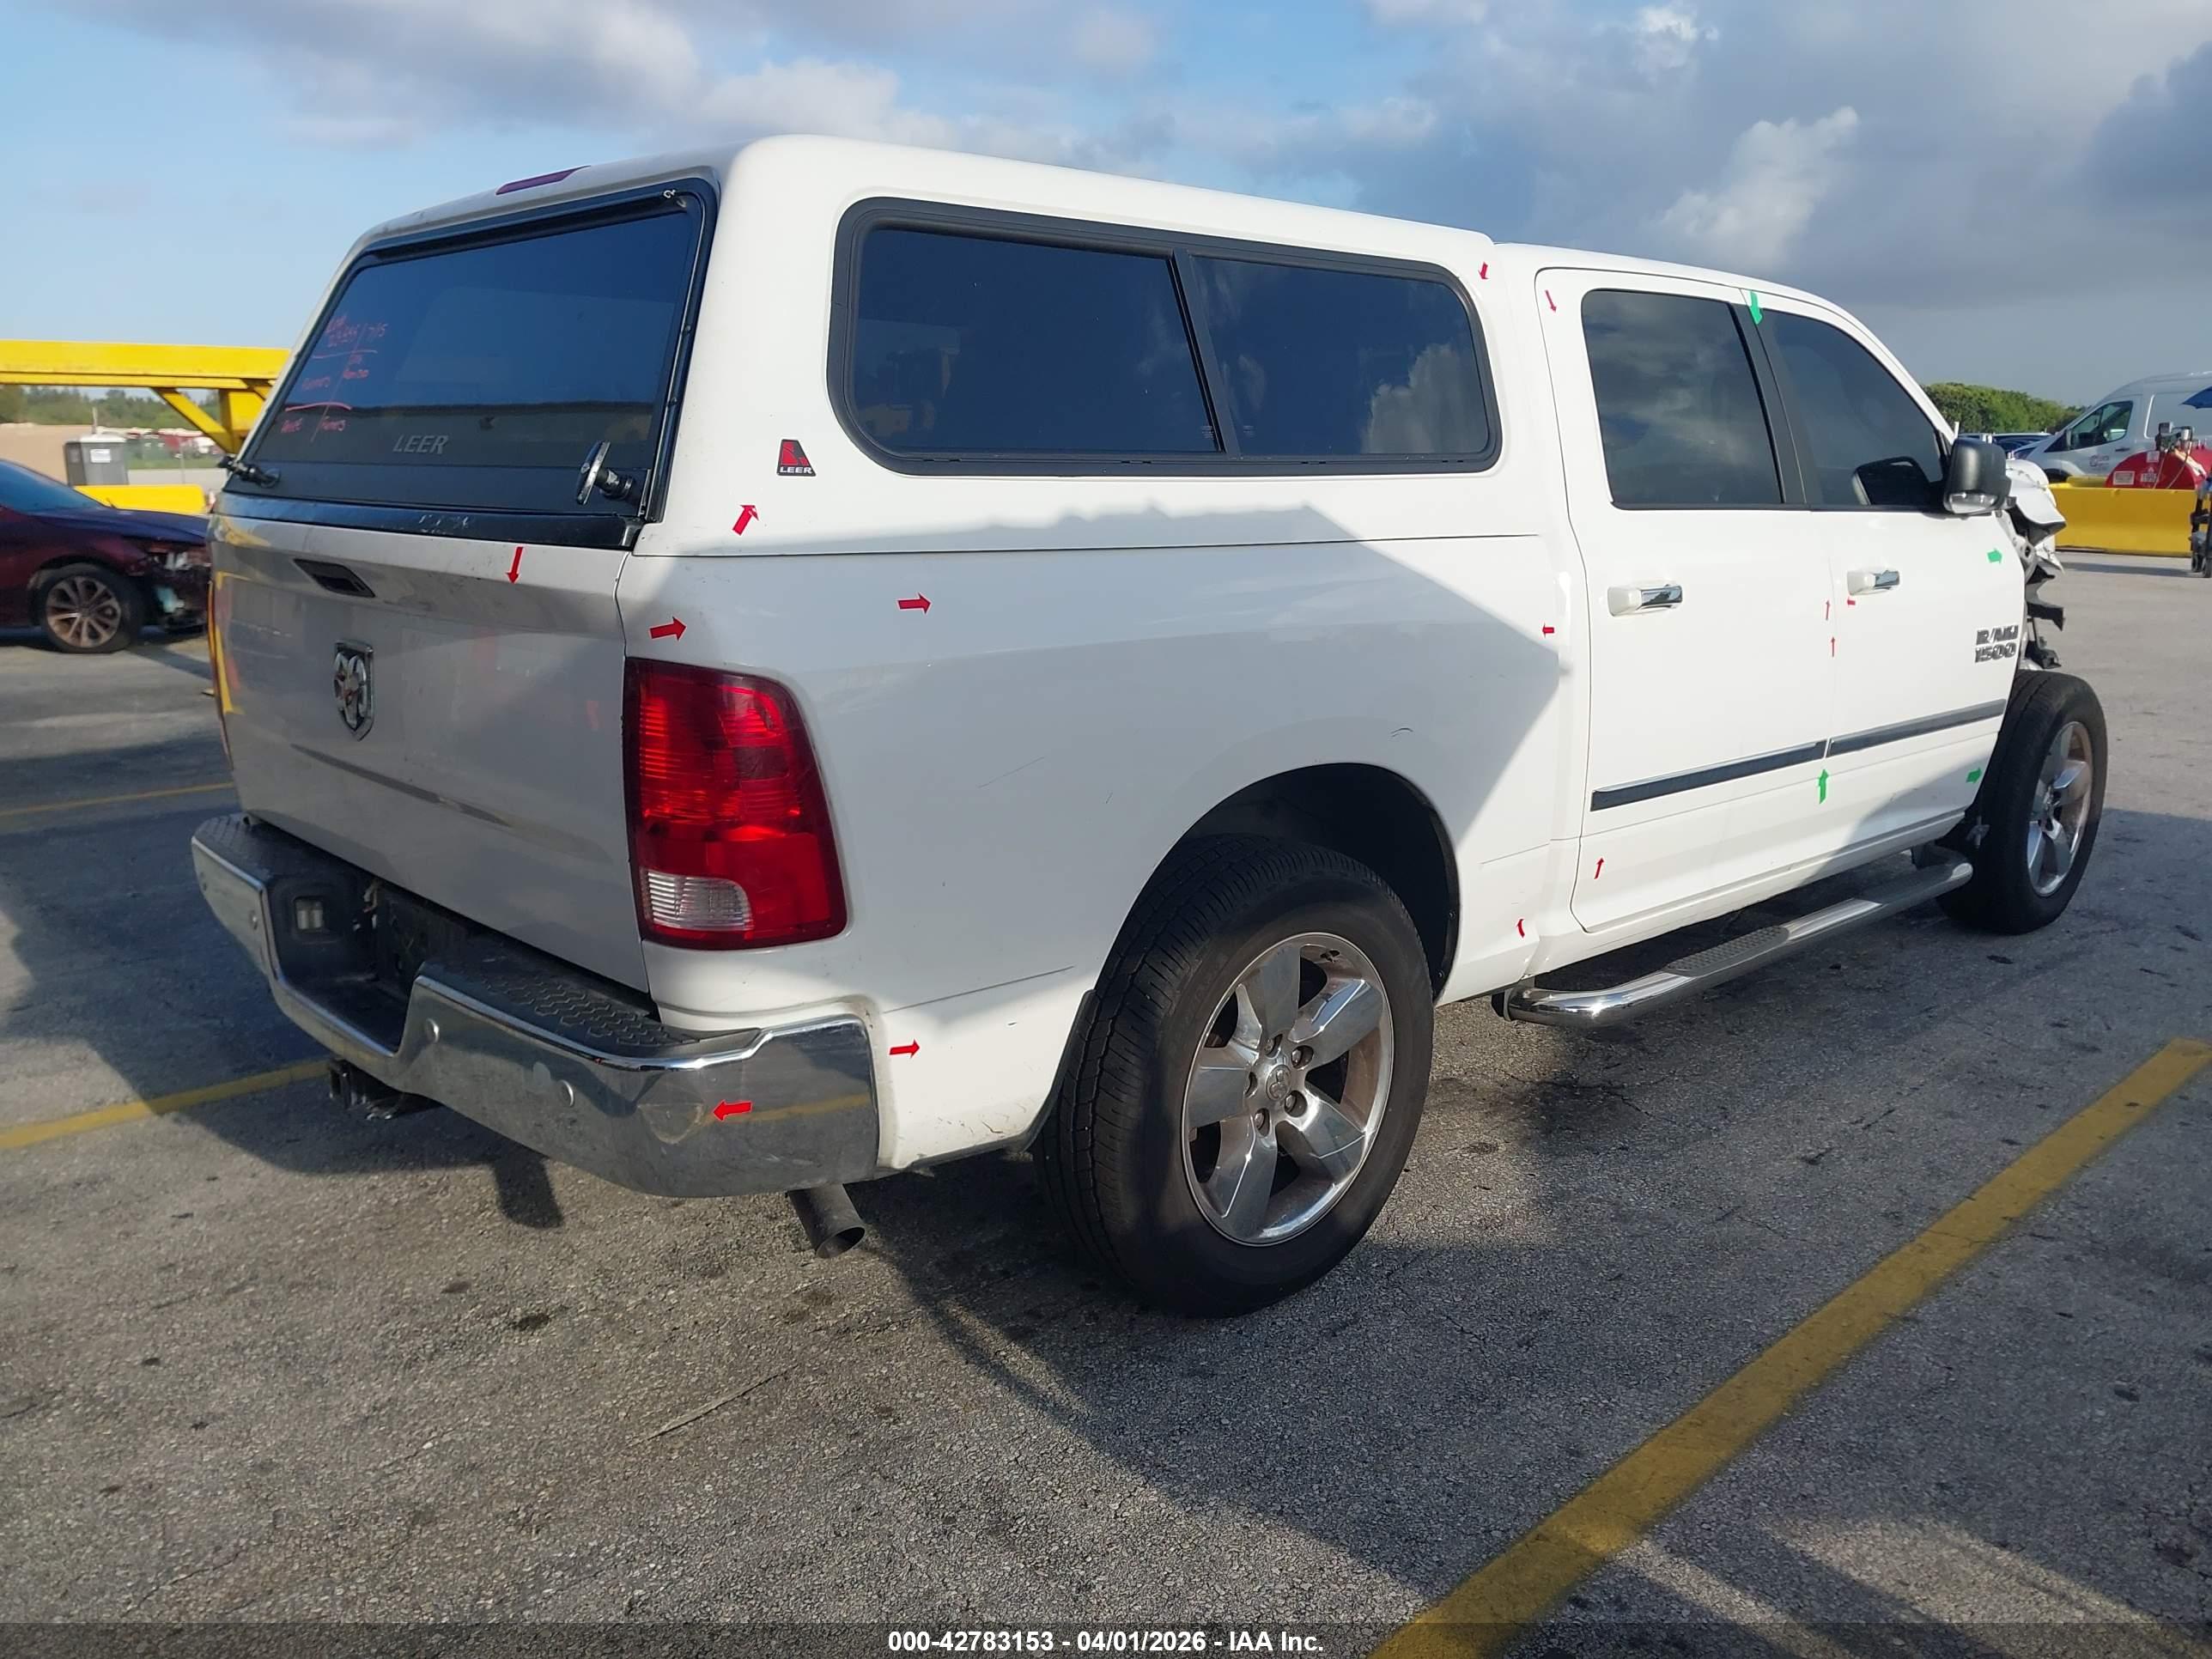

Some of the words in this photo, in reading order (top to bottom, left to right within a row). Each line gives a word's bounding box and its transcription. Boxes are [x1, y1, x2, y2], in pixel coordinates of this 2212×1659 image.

[392, 434, 448, 454] LEER
[1976, 625, 2019, 646] RAM
[1975, 642, 2016, 663] 1500
